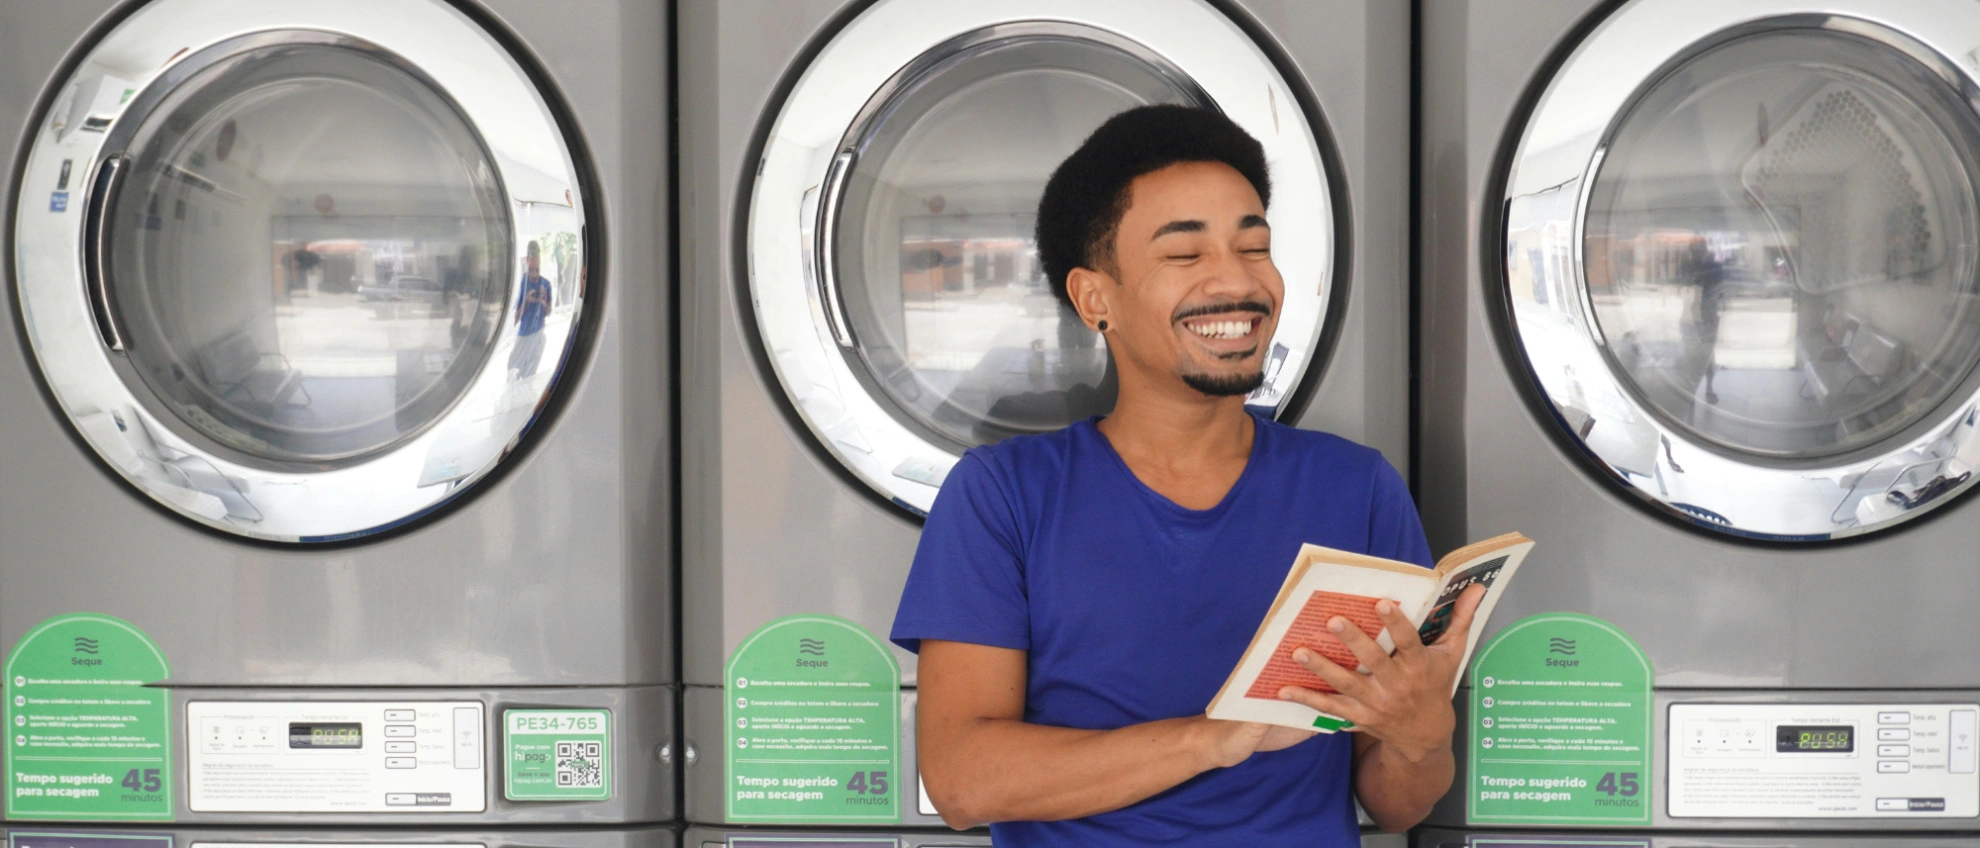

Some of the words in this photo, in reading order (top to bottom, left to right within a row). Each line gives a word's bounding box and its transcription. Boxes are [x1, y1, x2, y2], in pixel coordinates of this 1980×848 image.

[1441, 576, 1477, 596] OPUS
[1482, 569, 1500, 582] 86
[71, 657, 103, 666] Seque
[796, 658, 828, 668] Seque
[1545, 658, 1580, 668] Seque
[517, 718, 597, 730] PE34-765
[16, 773, 57, 786] Tempo
[60, 773, 113, 785] sugerido
[121, 768, 162, 792] 45
[737, 776, 779, 788] Tempo
[782, 776, 838, 788] sugerido
[846, 771, 888, 795] 45
[1480, 776, 1526, 788] Tempo
[1529, 776, 1586, 788] sugerido
[1596, 772, 1640, 796] 45
[16, 788, 43, 798] para
[46, 787, 99, 798] secagem
[121, 794, 162, 802] minutos
[737, 791, 764, 801] para
[767, 790, 823, 802] secagem
[1481, 790, 1510, 802] para
[1513, 790, 1571, 802] secagem
[846, 796, 889, 805] minutos
[1595, 797, 1640, 807] minutos
